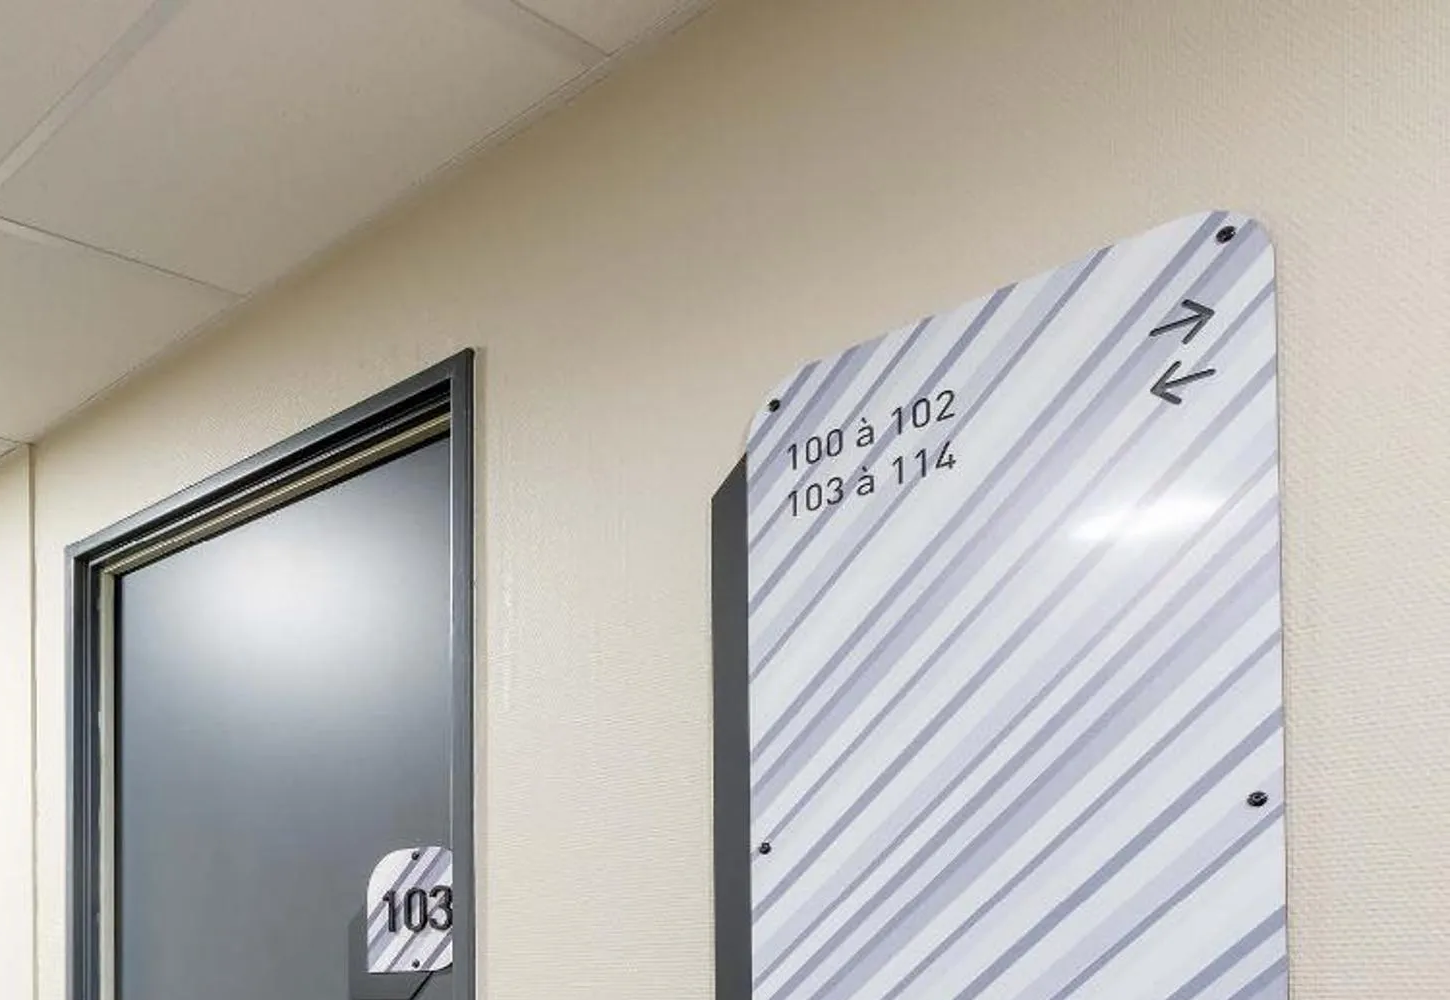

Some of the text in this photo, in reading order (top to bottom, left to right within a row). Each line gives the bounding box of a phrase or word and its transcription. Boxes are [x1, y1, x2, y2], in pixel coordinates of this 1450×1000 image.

[787, 389, 956, 471] 100 à 102
[787, 440, 956, 517] 103 à 114
[382, 884, 453, 933] 103
